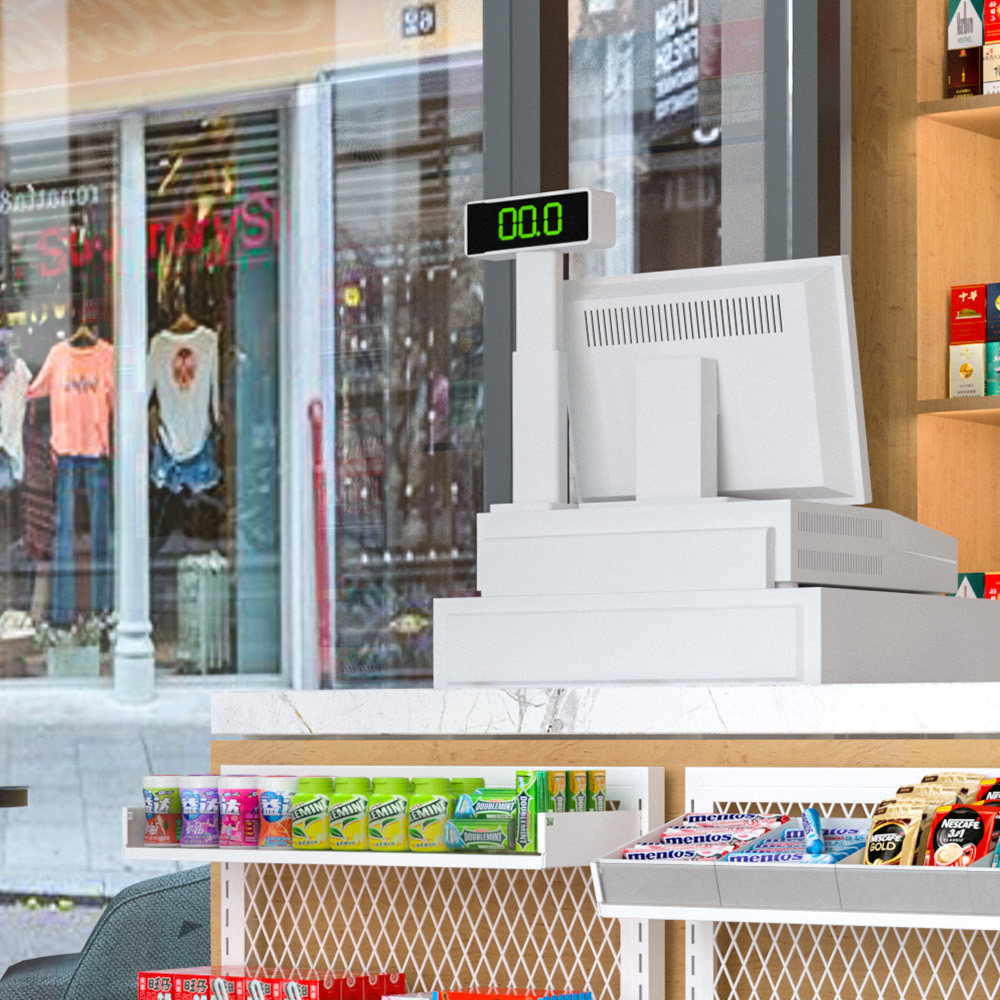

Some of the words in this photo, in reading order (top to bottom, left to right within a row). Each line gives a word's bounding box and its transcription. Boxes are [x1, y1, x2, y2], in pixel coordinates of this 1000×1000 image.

[498, 202, 562, 240] 00.0
[476, 802, 514, 811] DOUBLEMINT
[519, 796, 527, 843] DOUBLEMINT
[689, 813, 756, 823] mentos
[464, 831, 501, 842] DOUBLEMINT
[666, 833, 732, 845] mentos
[870, 842, 896, 852] GOLD
[627, 850, 695, 861] mentos
[728, 852, 802, 863] mentos
[148, 977, 172, 991] 旺仔
[183, 978, 208, 993] 旺仔
